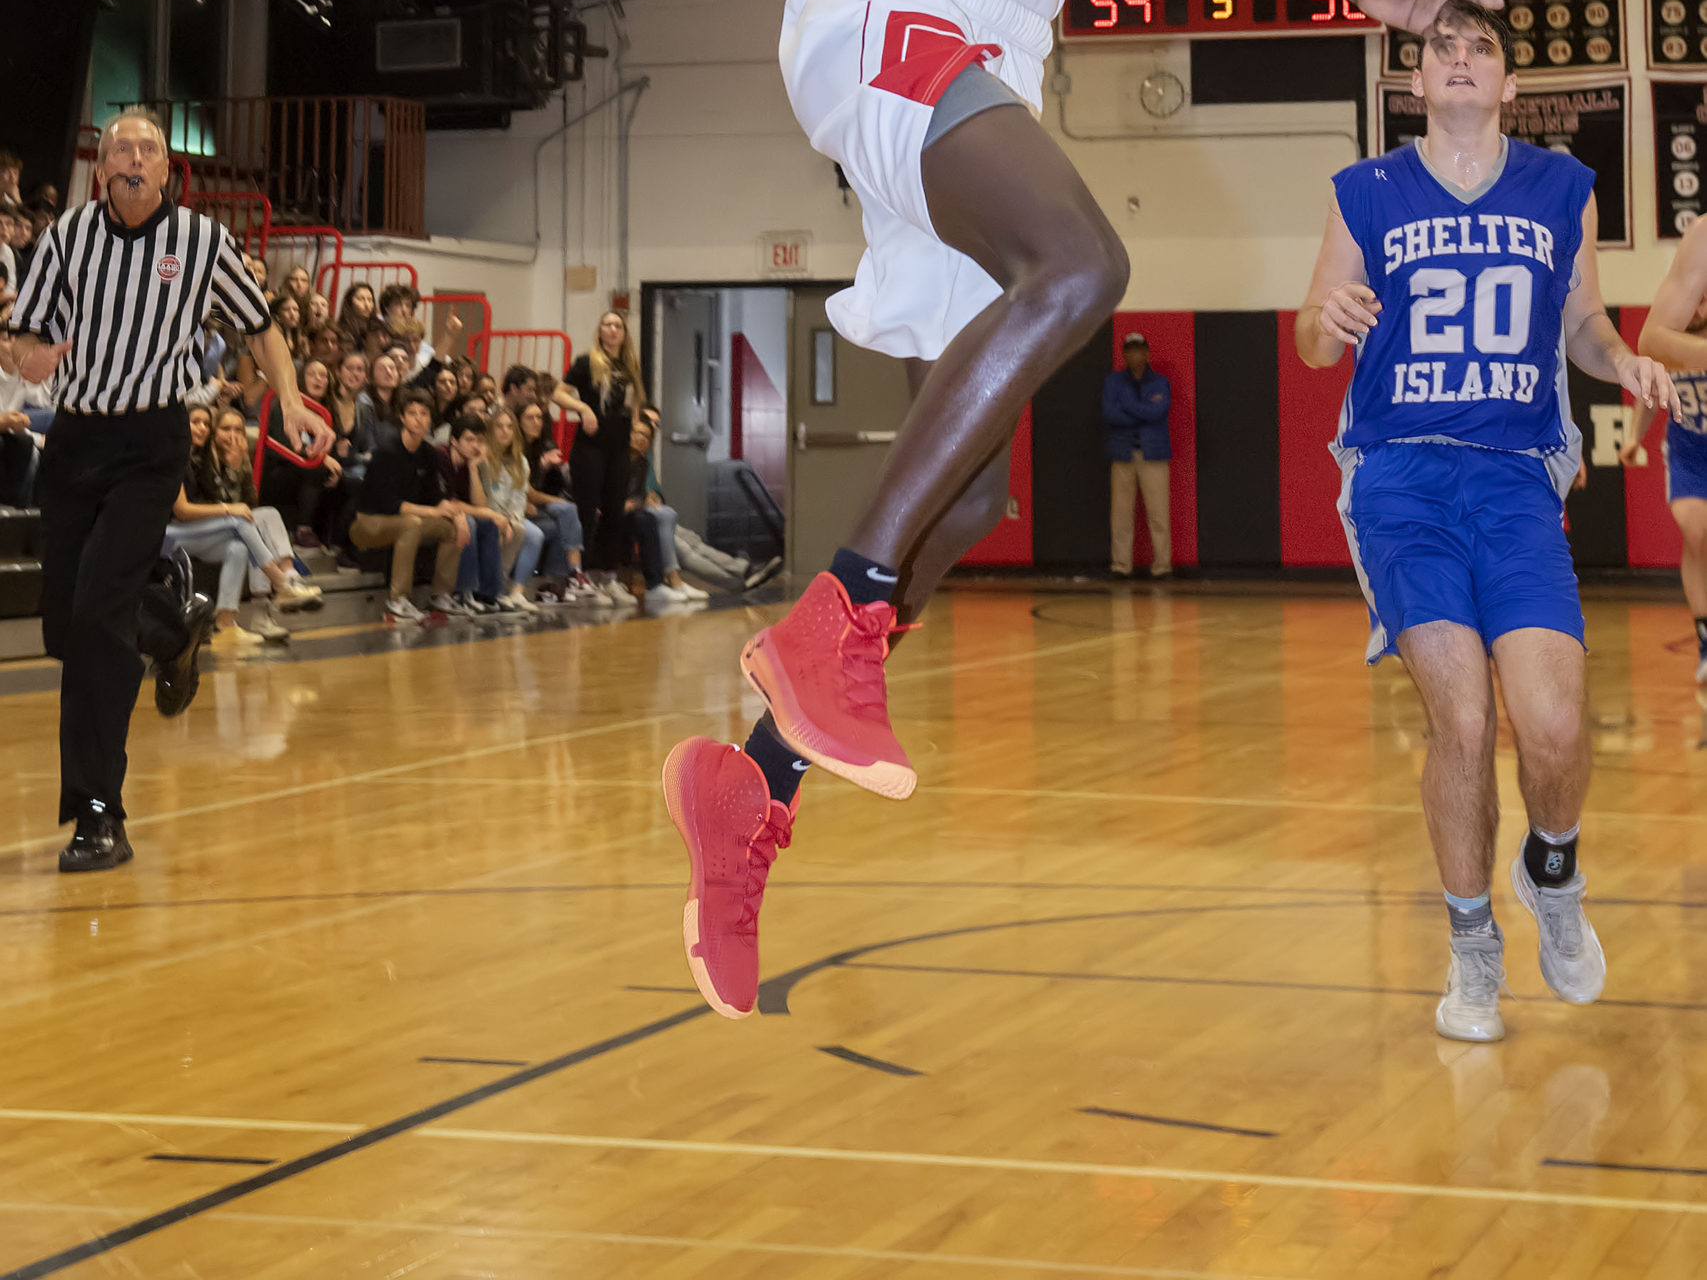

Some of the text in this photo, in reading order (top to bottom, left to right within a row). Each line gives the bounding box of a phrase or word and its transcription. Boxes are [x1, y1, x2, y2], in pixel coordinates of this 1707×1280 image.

[772, 242, 800, 267] EXIT
[1384, 214, 1555, 276] SHELTER
[1409, 265, 1533, 355] 20
[1391, 361, 1540, 404] ISLAND
